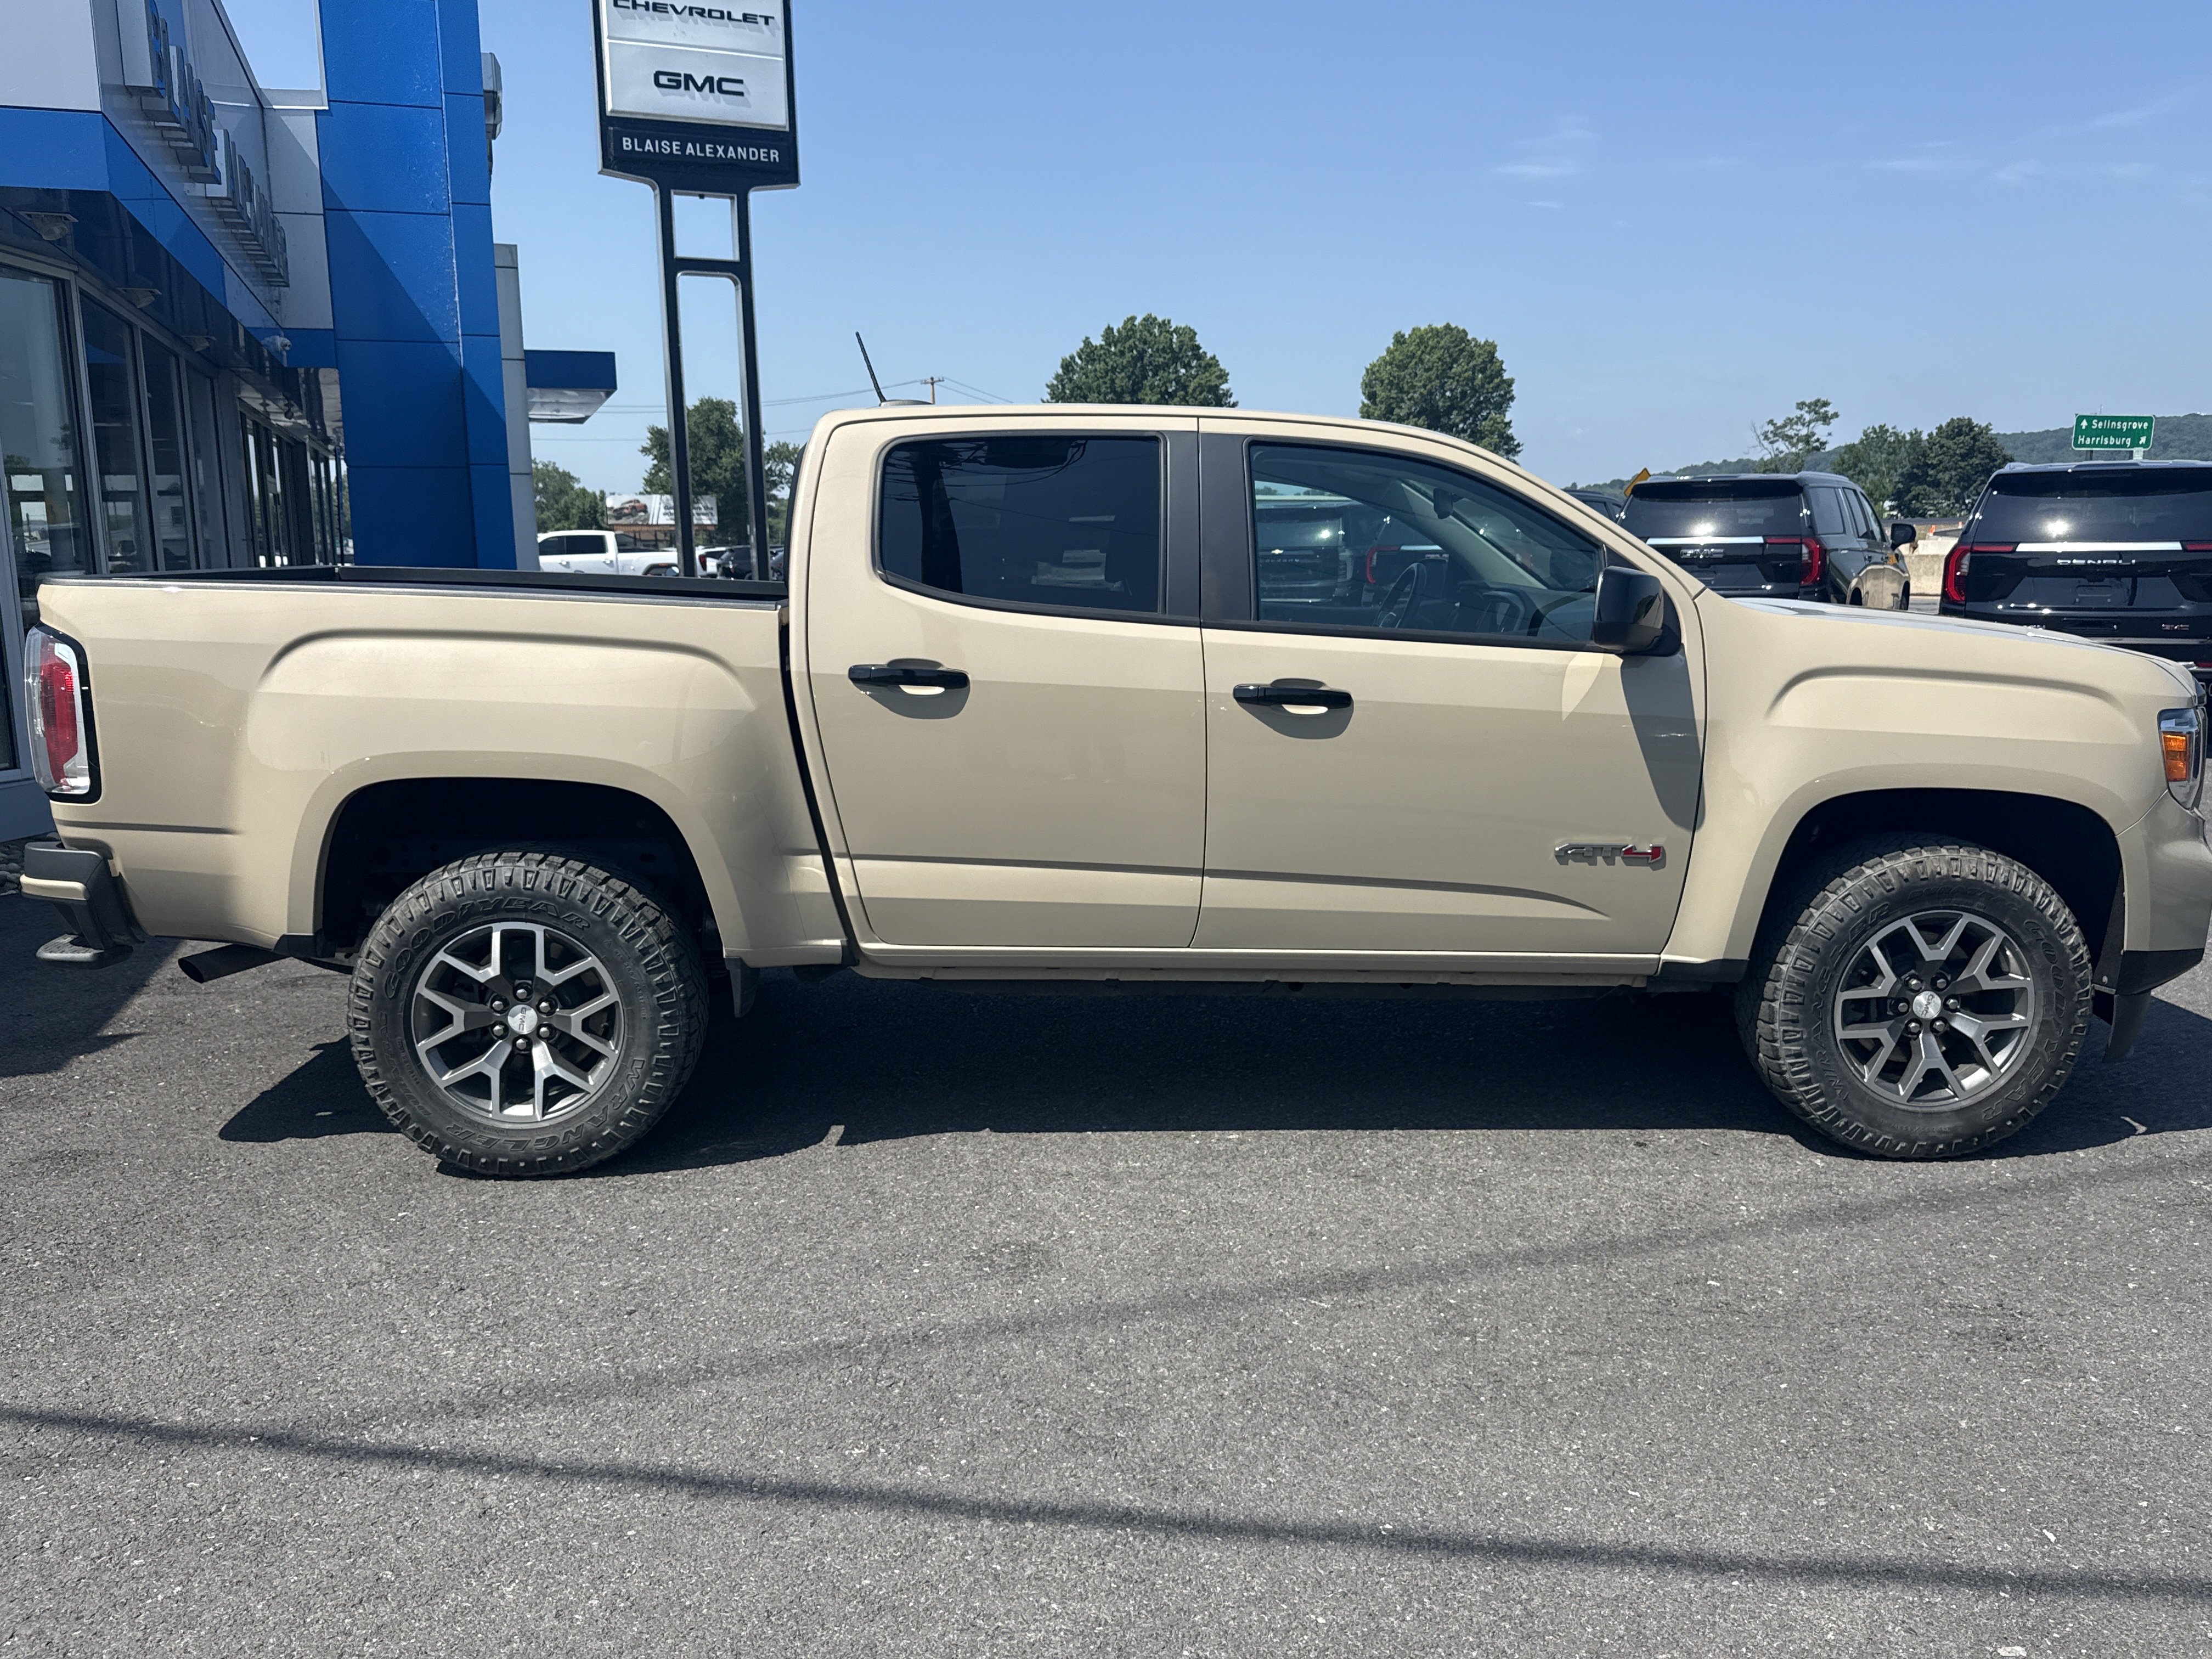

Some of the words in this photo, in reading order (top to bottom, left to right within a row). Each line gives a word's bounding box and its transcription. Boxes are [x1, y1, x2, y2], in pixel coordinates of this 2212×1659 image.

[613, 0, 775, 25] CHEVROLET
[653, 70, 744, 97] GMC
[622, 137, 681, 155] BLAISE
[686, 143, 780, 162] ALEXANDER
[2091, 419, 2148, 432] Selinsgrove
[2078, 435, 2131, 448] Harrisburg
[385, 897, 591, 998] GOODYEAR
[1921, 994, 1935, 1017] GMC
[518, 1007, 527, 1031] GMC
[1982, 919, 2066, 1121] GOODYEAR
[447, 1058, 645, 1151] WRANGLER
